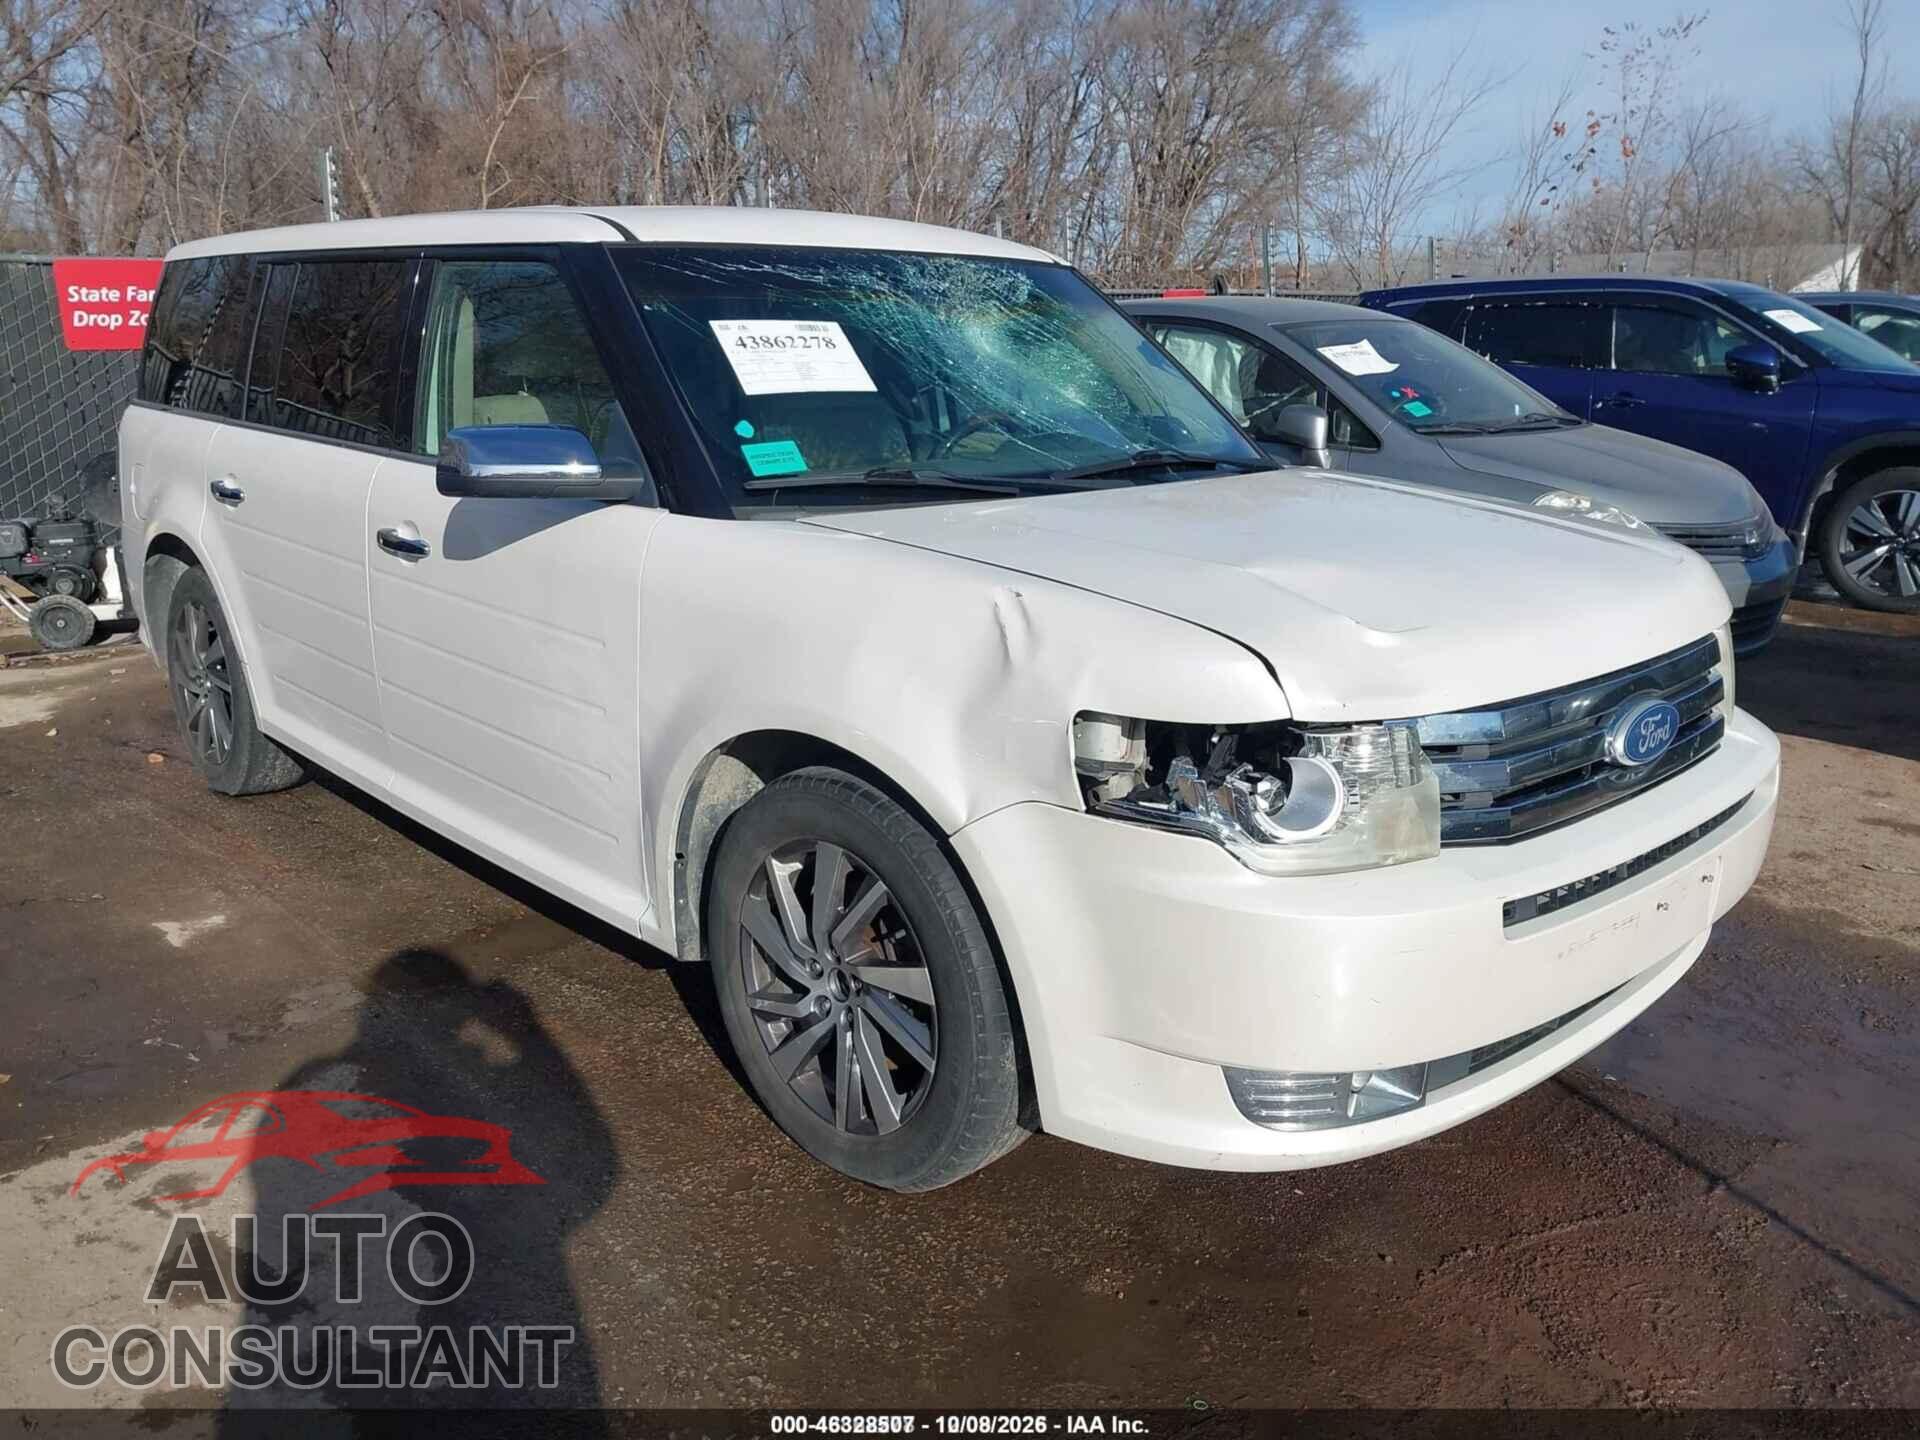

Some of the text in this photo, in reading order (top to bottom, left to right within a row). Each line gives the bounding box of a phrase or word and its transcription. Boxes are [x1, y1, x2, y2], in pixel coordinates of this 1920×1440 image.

[67, 285, 156, 303] State Far
[73, 310, 124, 331] Drop
[735, 335, 837, 350] 43862278
[1639, 713, 1671, 754] Ford
